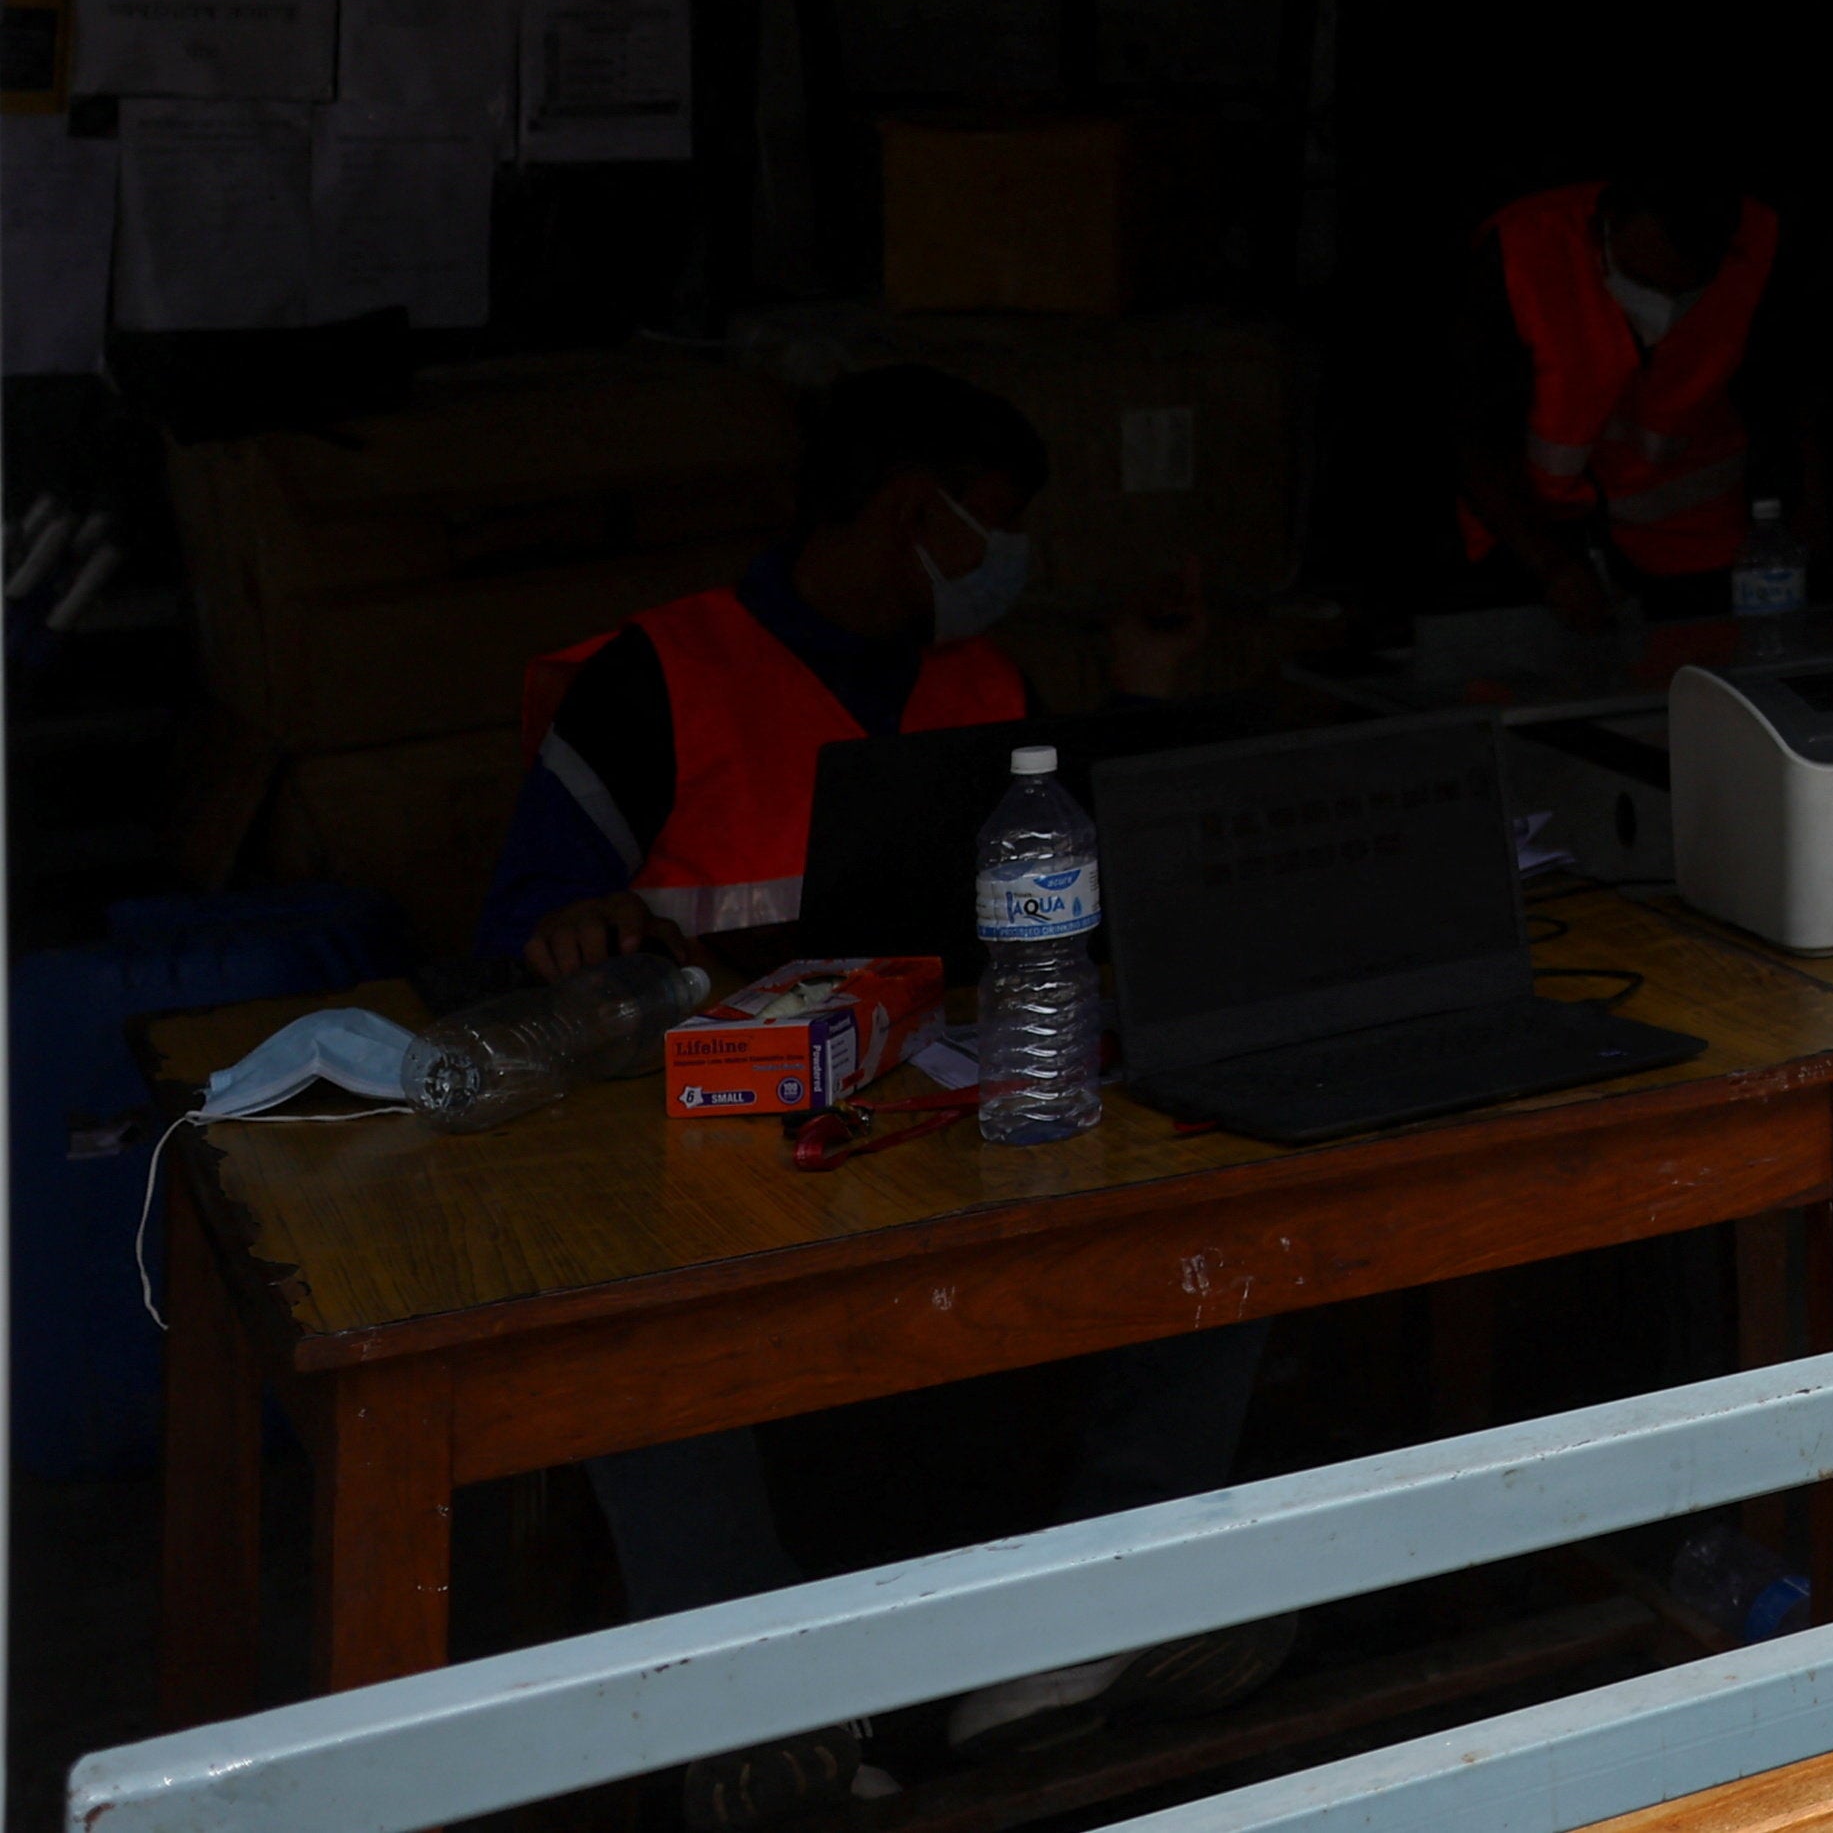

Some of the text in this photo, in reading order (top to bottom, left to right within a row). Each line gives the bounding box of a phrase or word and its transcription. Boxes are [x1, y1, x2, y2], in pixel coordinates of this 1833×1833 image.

[1013, 896, 1065, 919] AQUA
[674, 1037, 747, 1056] Lifeline
[812, 1044, 822, 1093] Powdered
[686, 1090, 744, 1104] 6 SMALL
